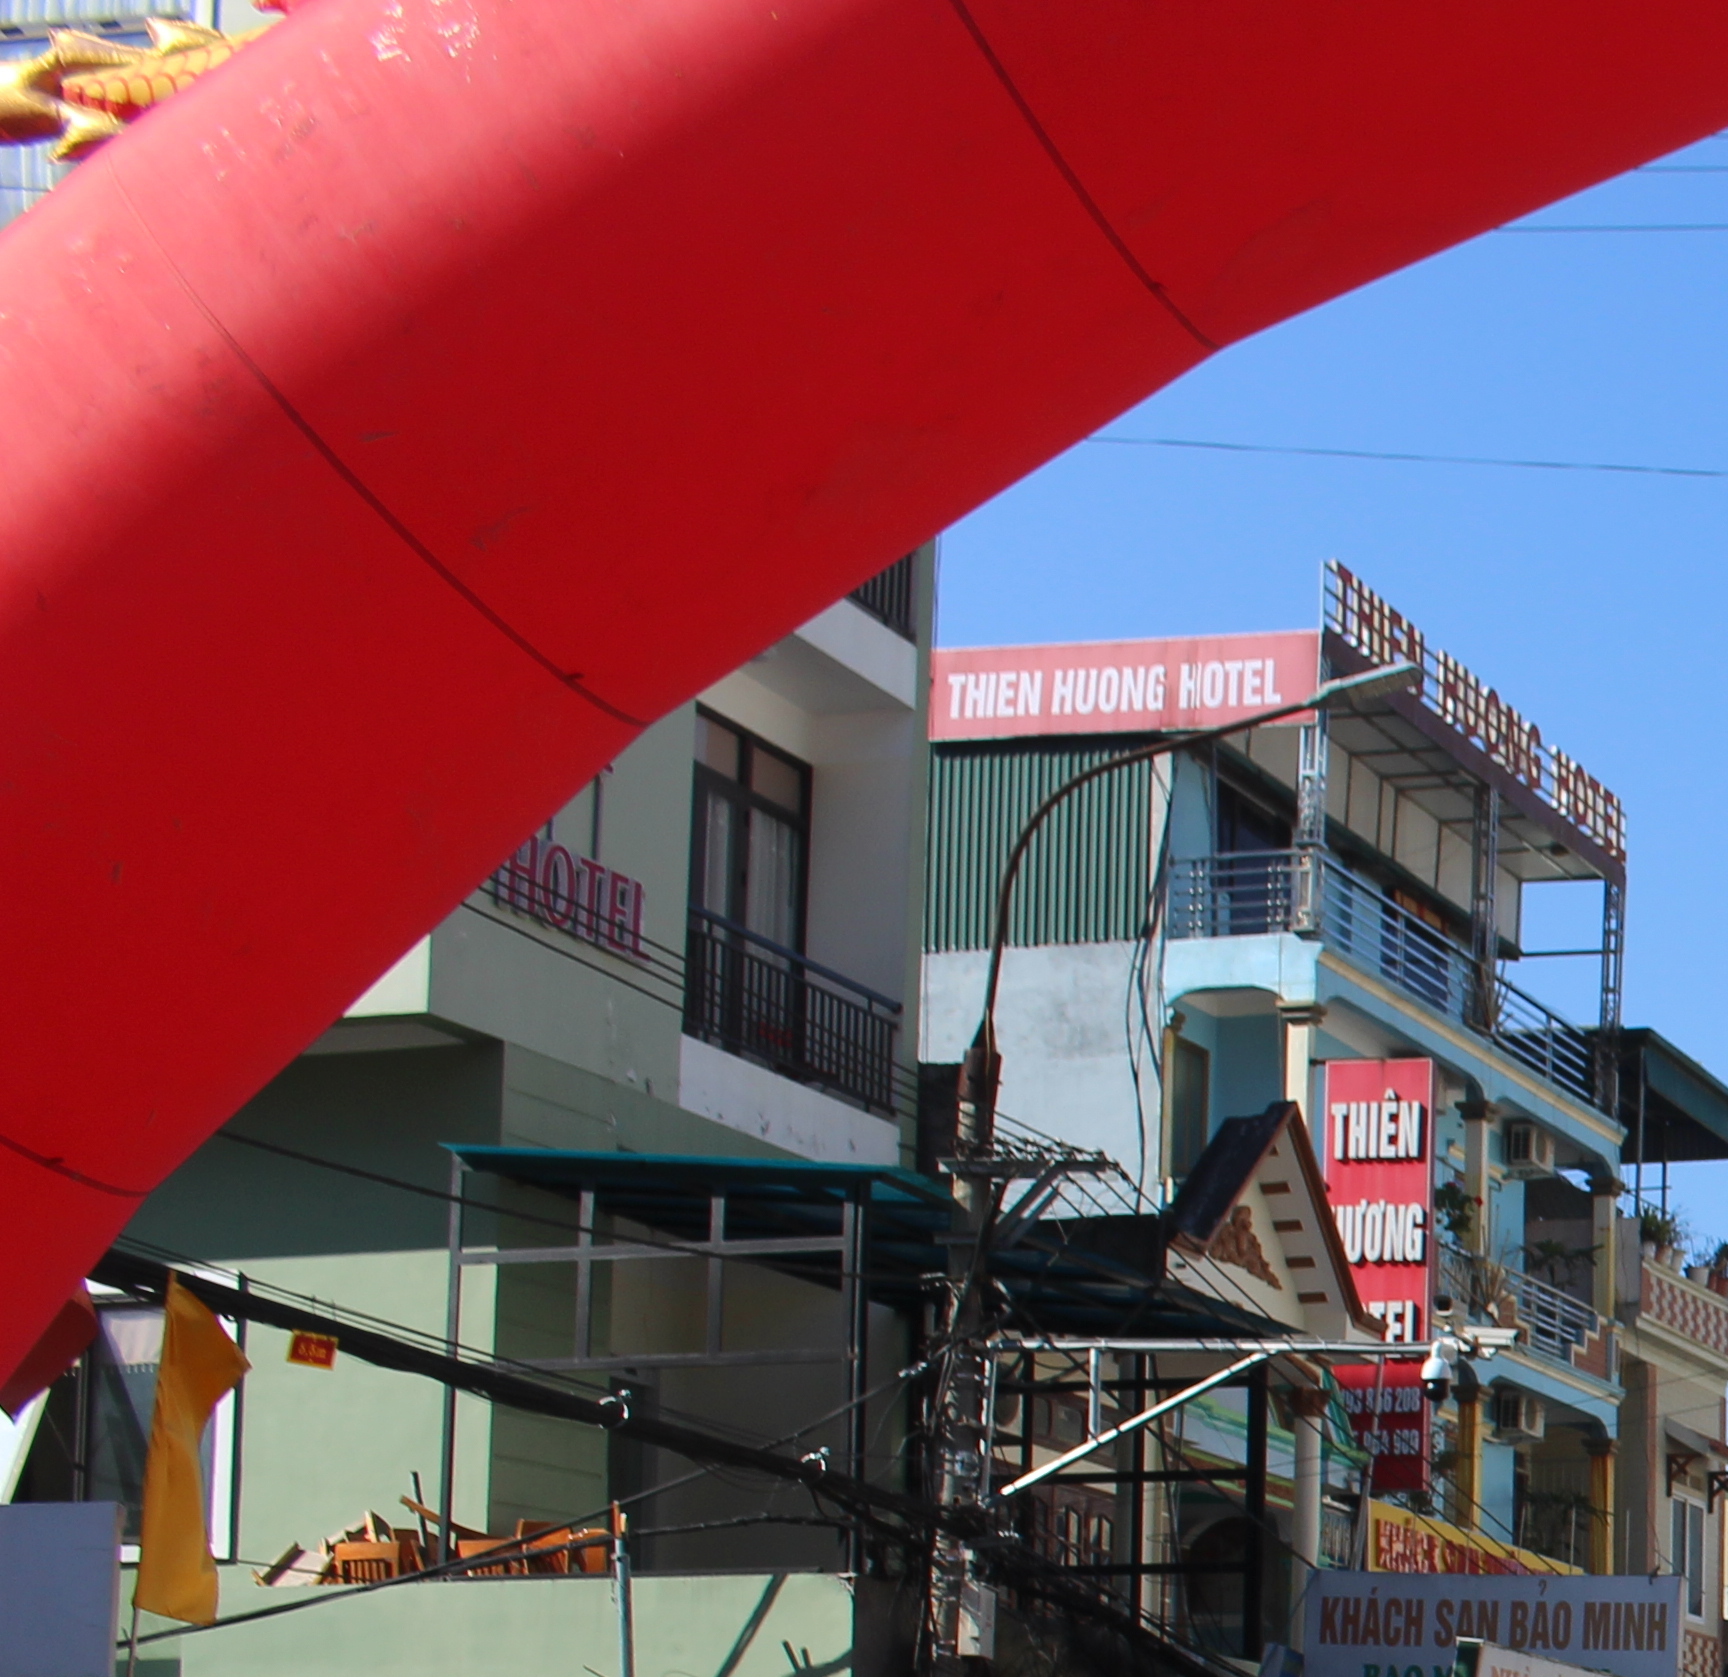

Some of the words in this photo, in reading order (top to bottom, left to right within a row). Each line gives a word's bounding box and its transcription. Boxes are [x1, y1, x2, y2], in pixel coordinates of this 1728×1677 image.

[947, 671, 1041, 720] THIEN
[1051, 664, 1167, 714] HUONG
[1180, 657, 1282, 711] HOTEL
[496, 834, 653, 962] HOTEL
[1331, 1089, 1423, 1161] THIÊN
[1319, 1587, 1425, 1648] KHÁCH
[1509, 1578, 1573, 1651] BẢO
[1582, 1601, 1668, 1652] MINH
